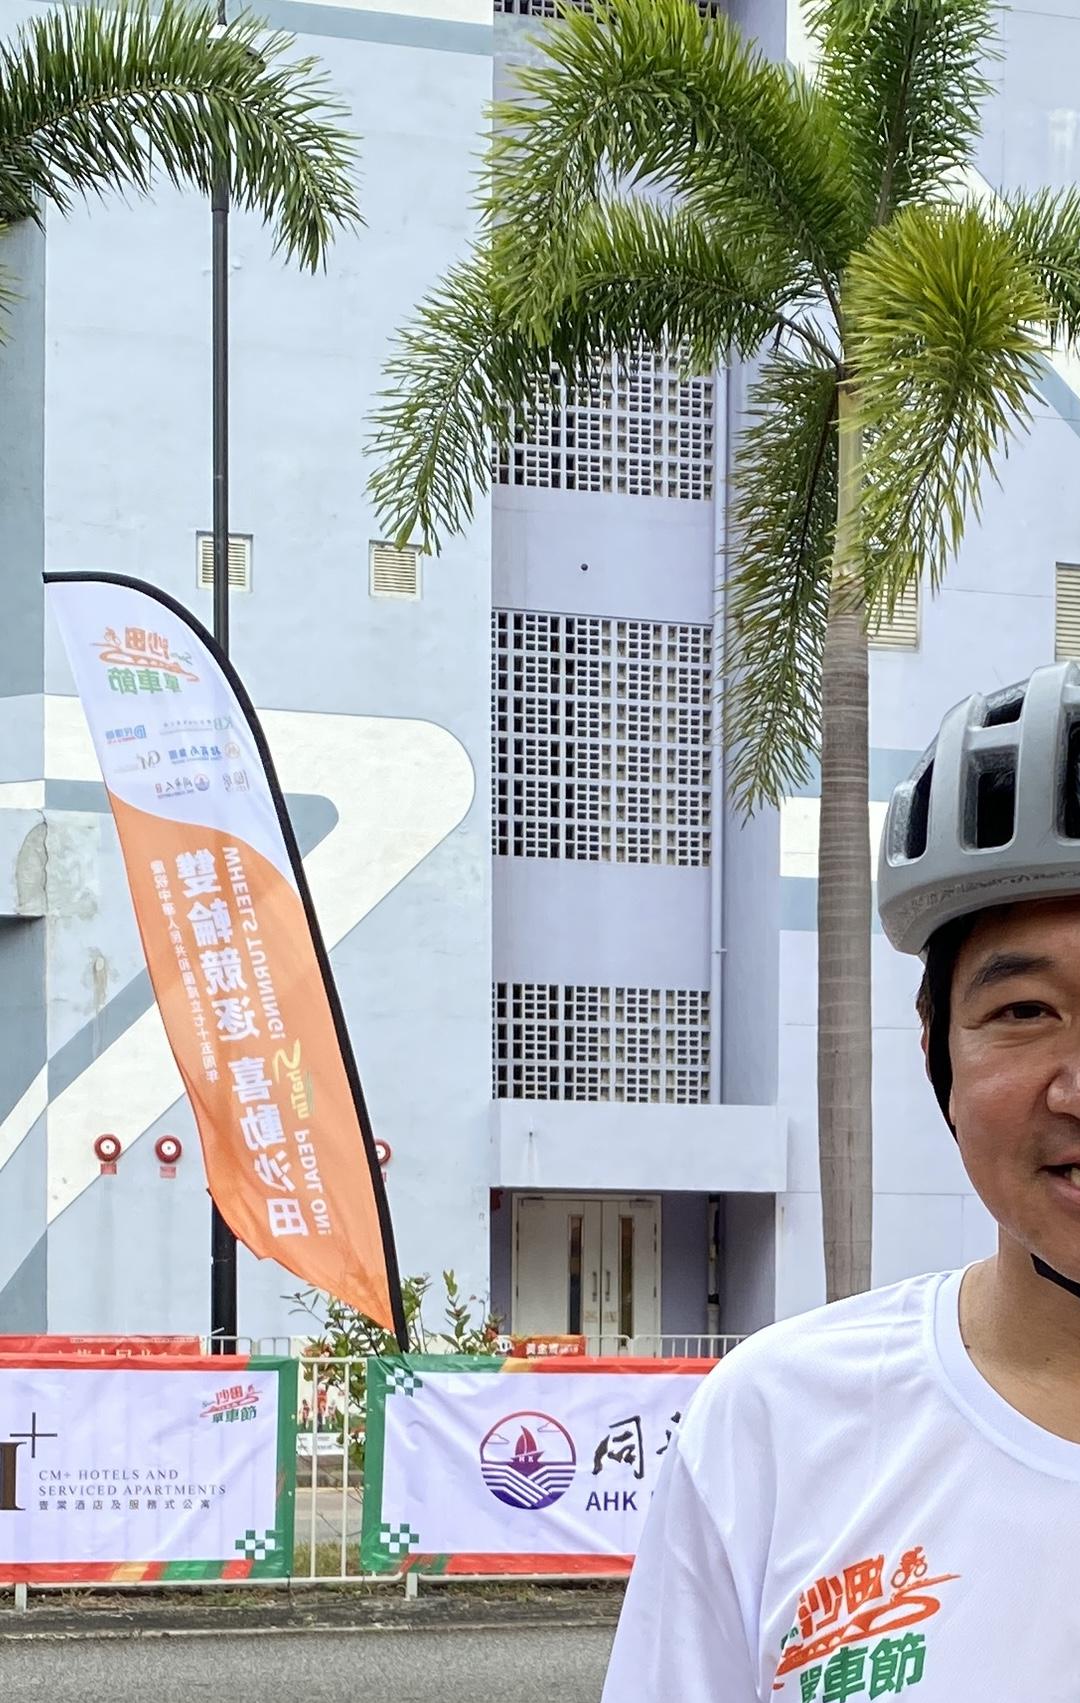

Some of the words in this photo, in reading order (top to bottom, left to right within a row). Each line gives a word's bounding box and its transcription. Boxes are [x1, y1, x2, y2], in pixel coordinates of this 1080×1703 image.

[38, 1469, 71, 1481] CM+
[78, 1469, 140, 1481] HOTELS
[145, 1469, 179, 1480] AND
[38, 1485, 118, 1497] SERVICED
[123, 1484, 227, 1496] APARTMENTS
[585, 1491, 639, 1512] AHK
